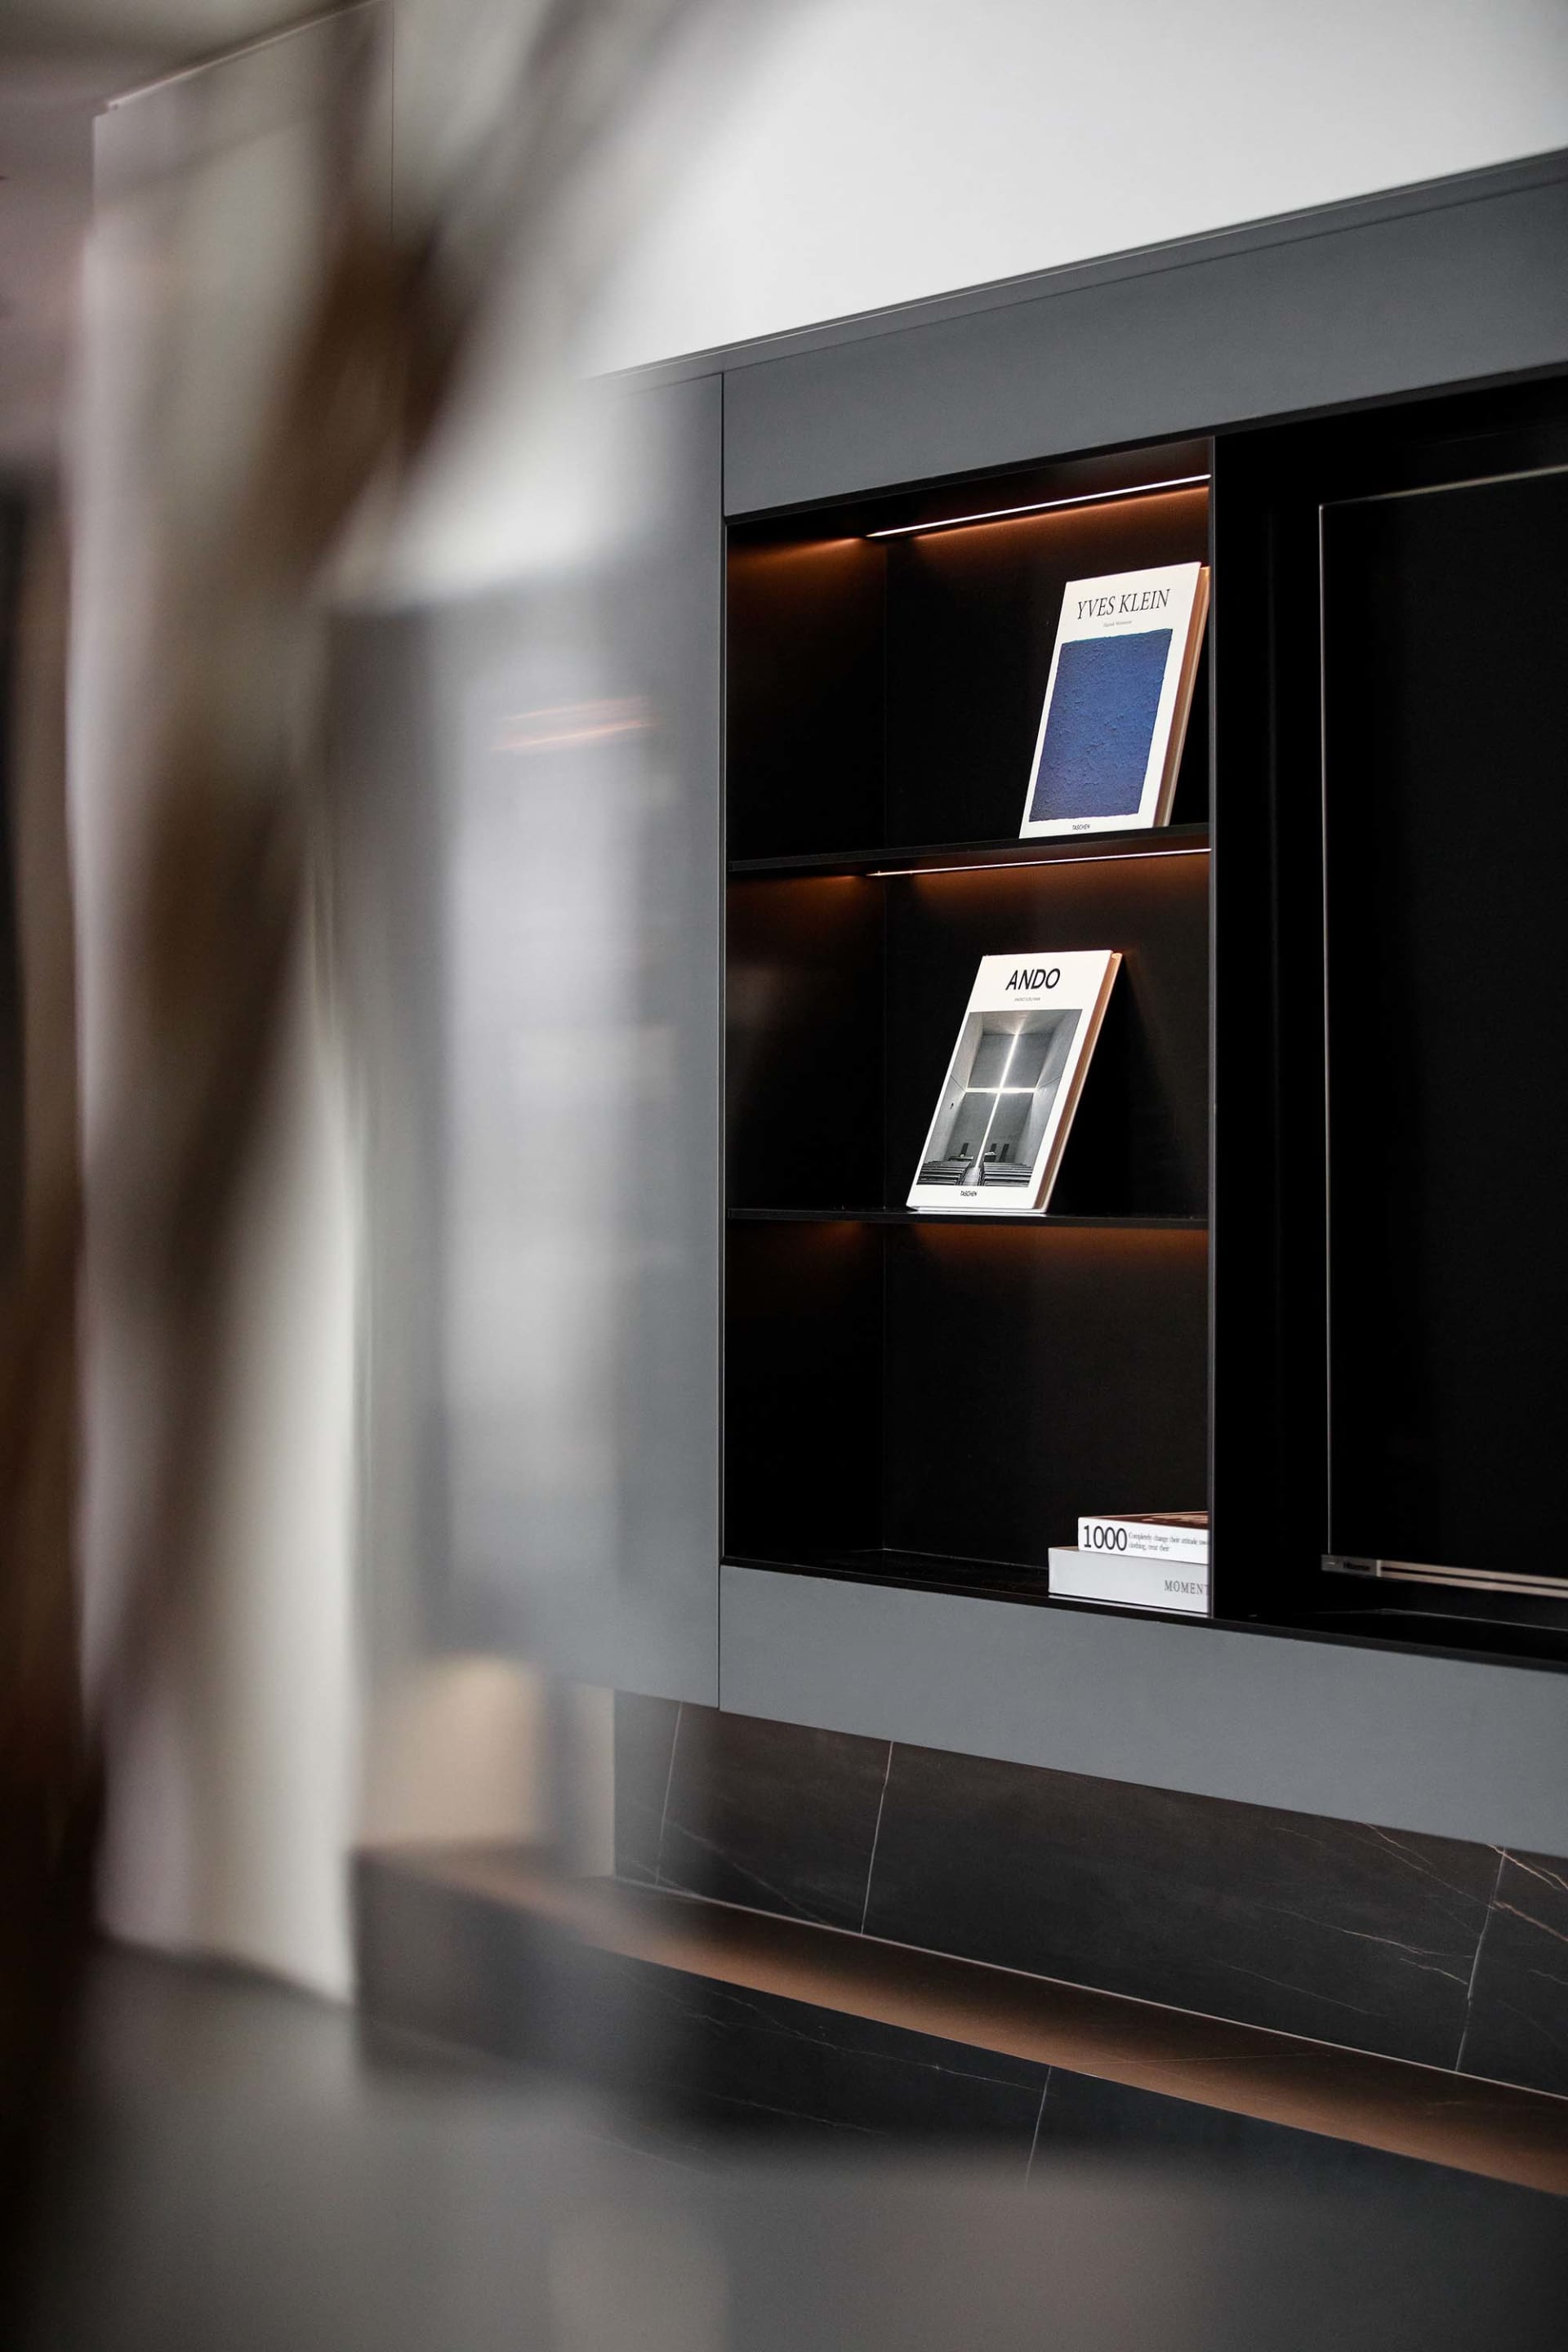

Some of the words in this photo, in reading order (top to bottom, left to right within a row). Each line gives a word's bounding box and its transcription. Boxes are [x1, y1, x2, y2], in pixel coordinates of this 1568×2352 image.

[1077, 595, 1116, 620] YVES
[1118, 589, 1170, 613] KLEIN
[1005, 968, 1061, 991] ANDO
[1084, 1525, 1127, 1551] 1000
